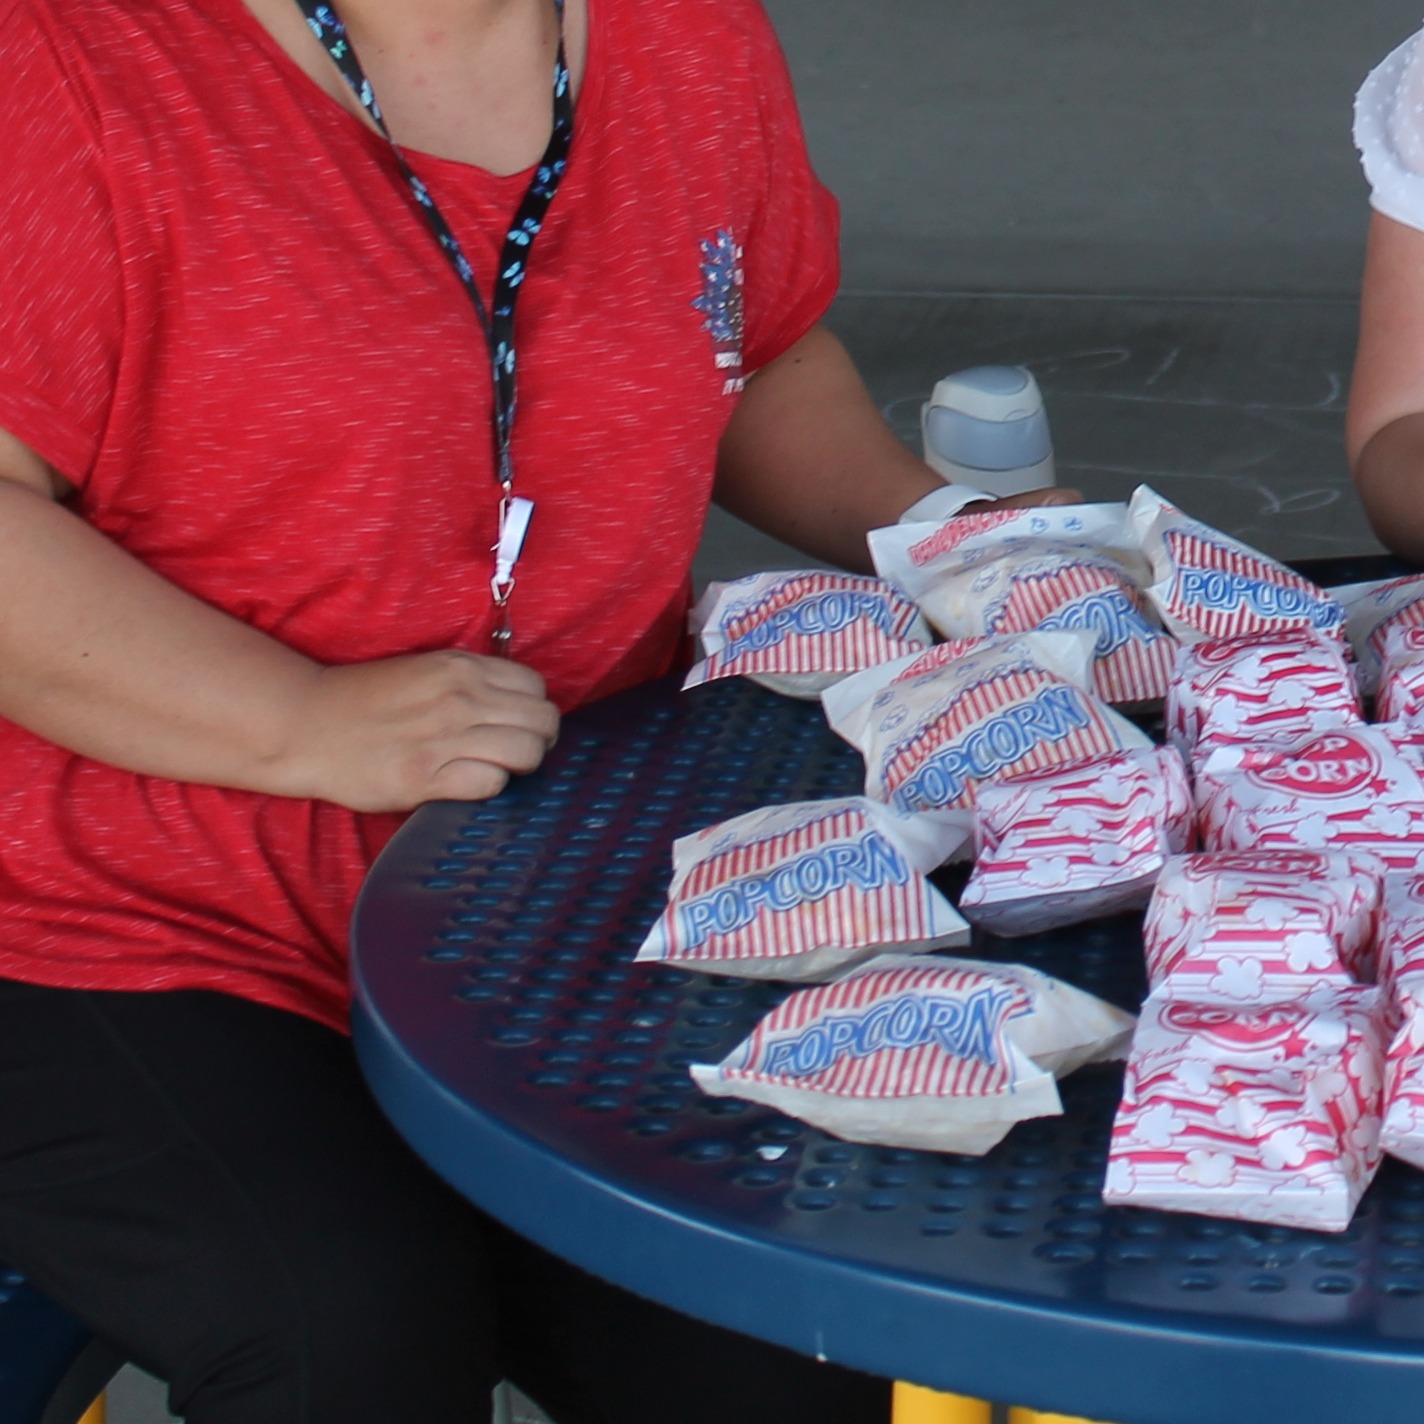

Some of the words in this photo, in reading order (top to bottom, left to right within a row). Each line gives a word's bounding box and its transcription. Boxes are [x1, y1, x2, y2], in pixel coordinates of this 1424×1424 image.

[893, 685, 1092, 815] POPCORN
[678, 829, 911, 950] POPCORN
[762, 987, 1015, 1078] POPCORN
